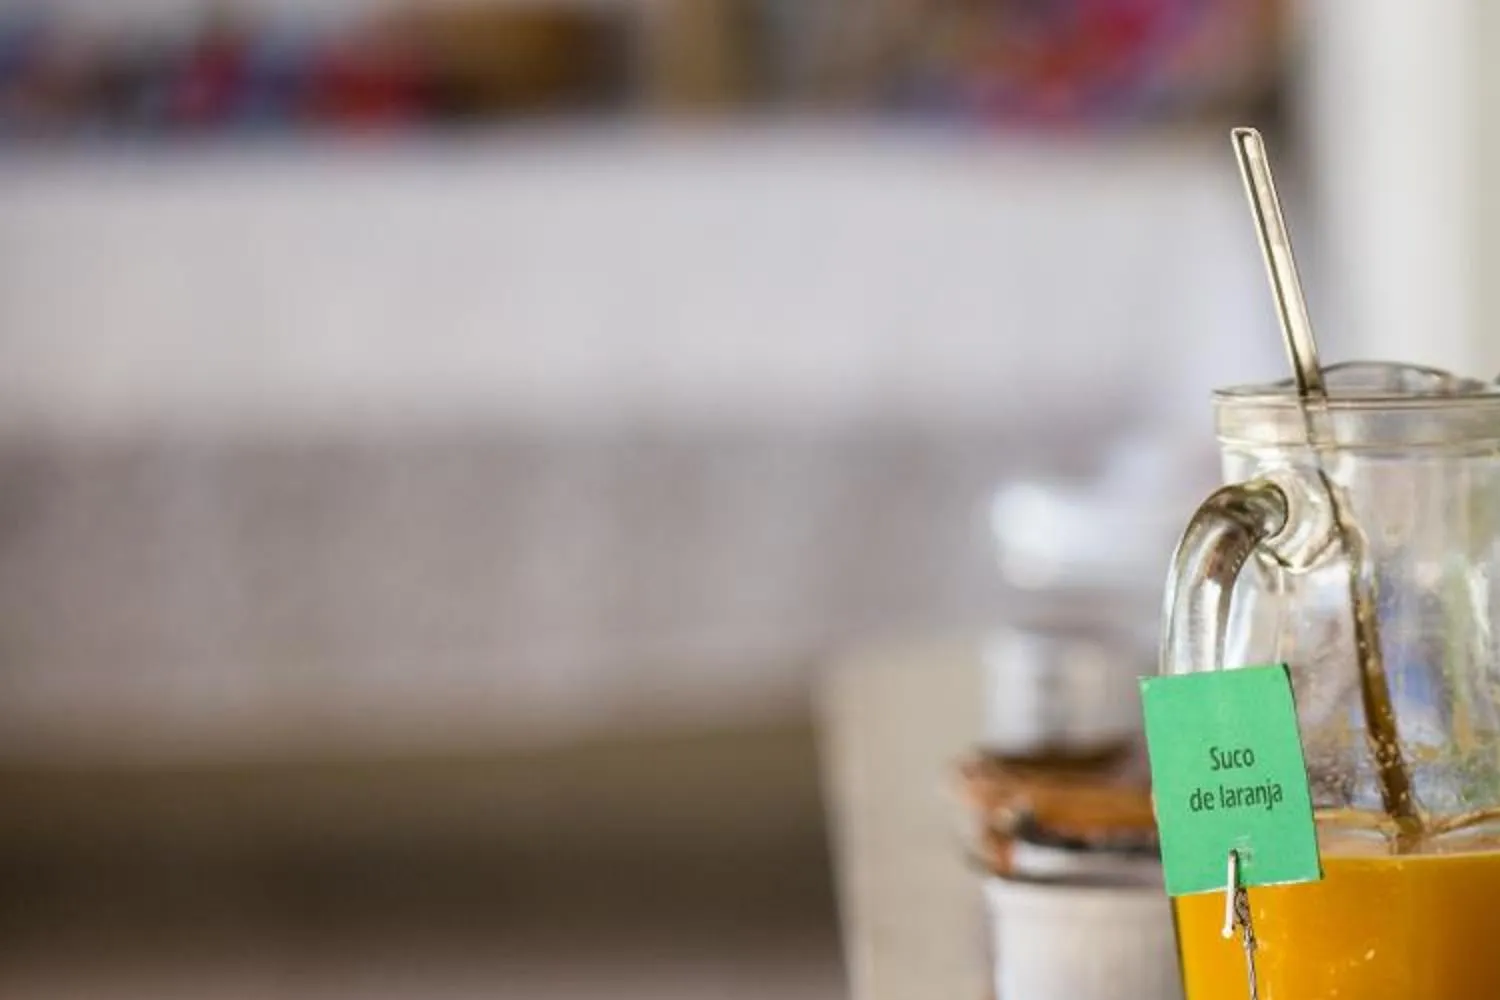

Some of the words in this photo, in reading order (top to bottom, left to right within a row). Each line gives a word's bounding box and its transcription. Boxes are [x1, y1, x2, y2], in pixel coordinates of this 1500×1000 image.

[1209, 746, 1255, 771] Suco
[1189, 787, 1215, 812] de
[1219, 778, 1283, 811] laranja
